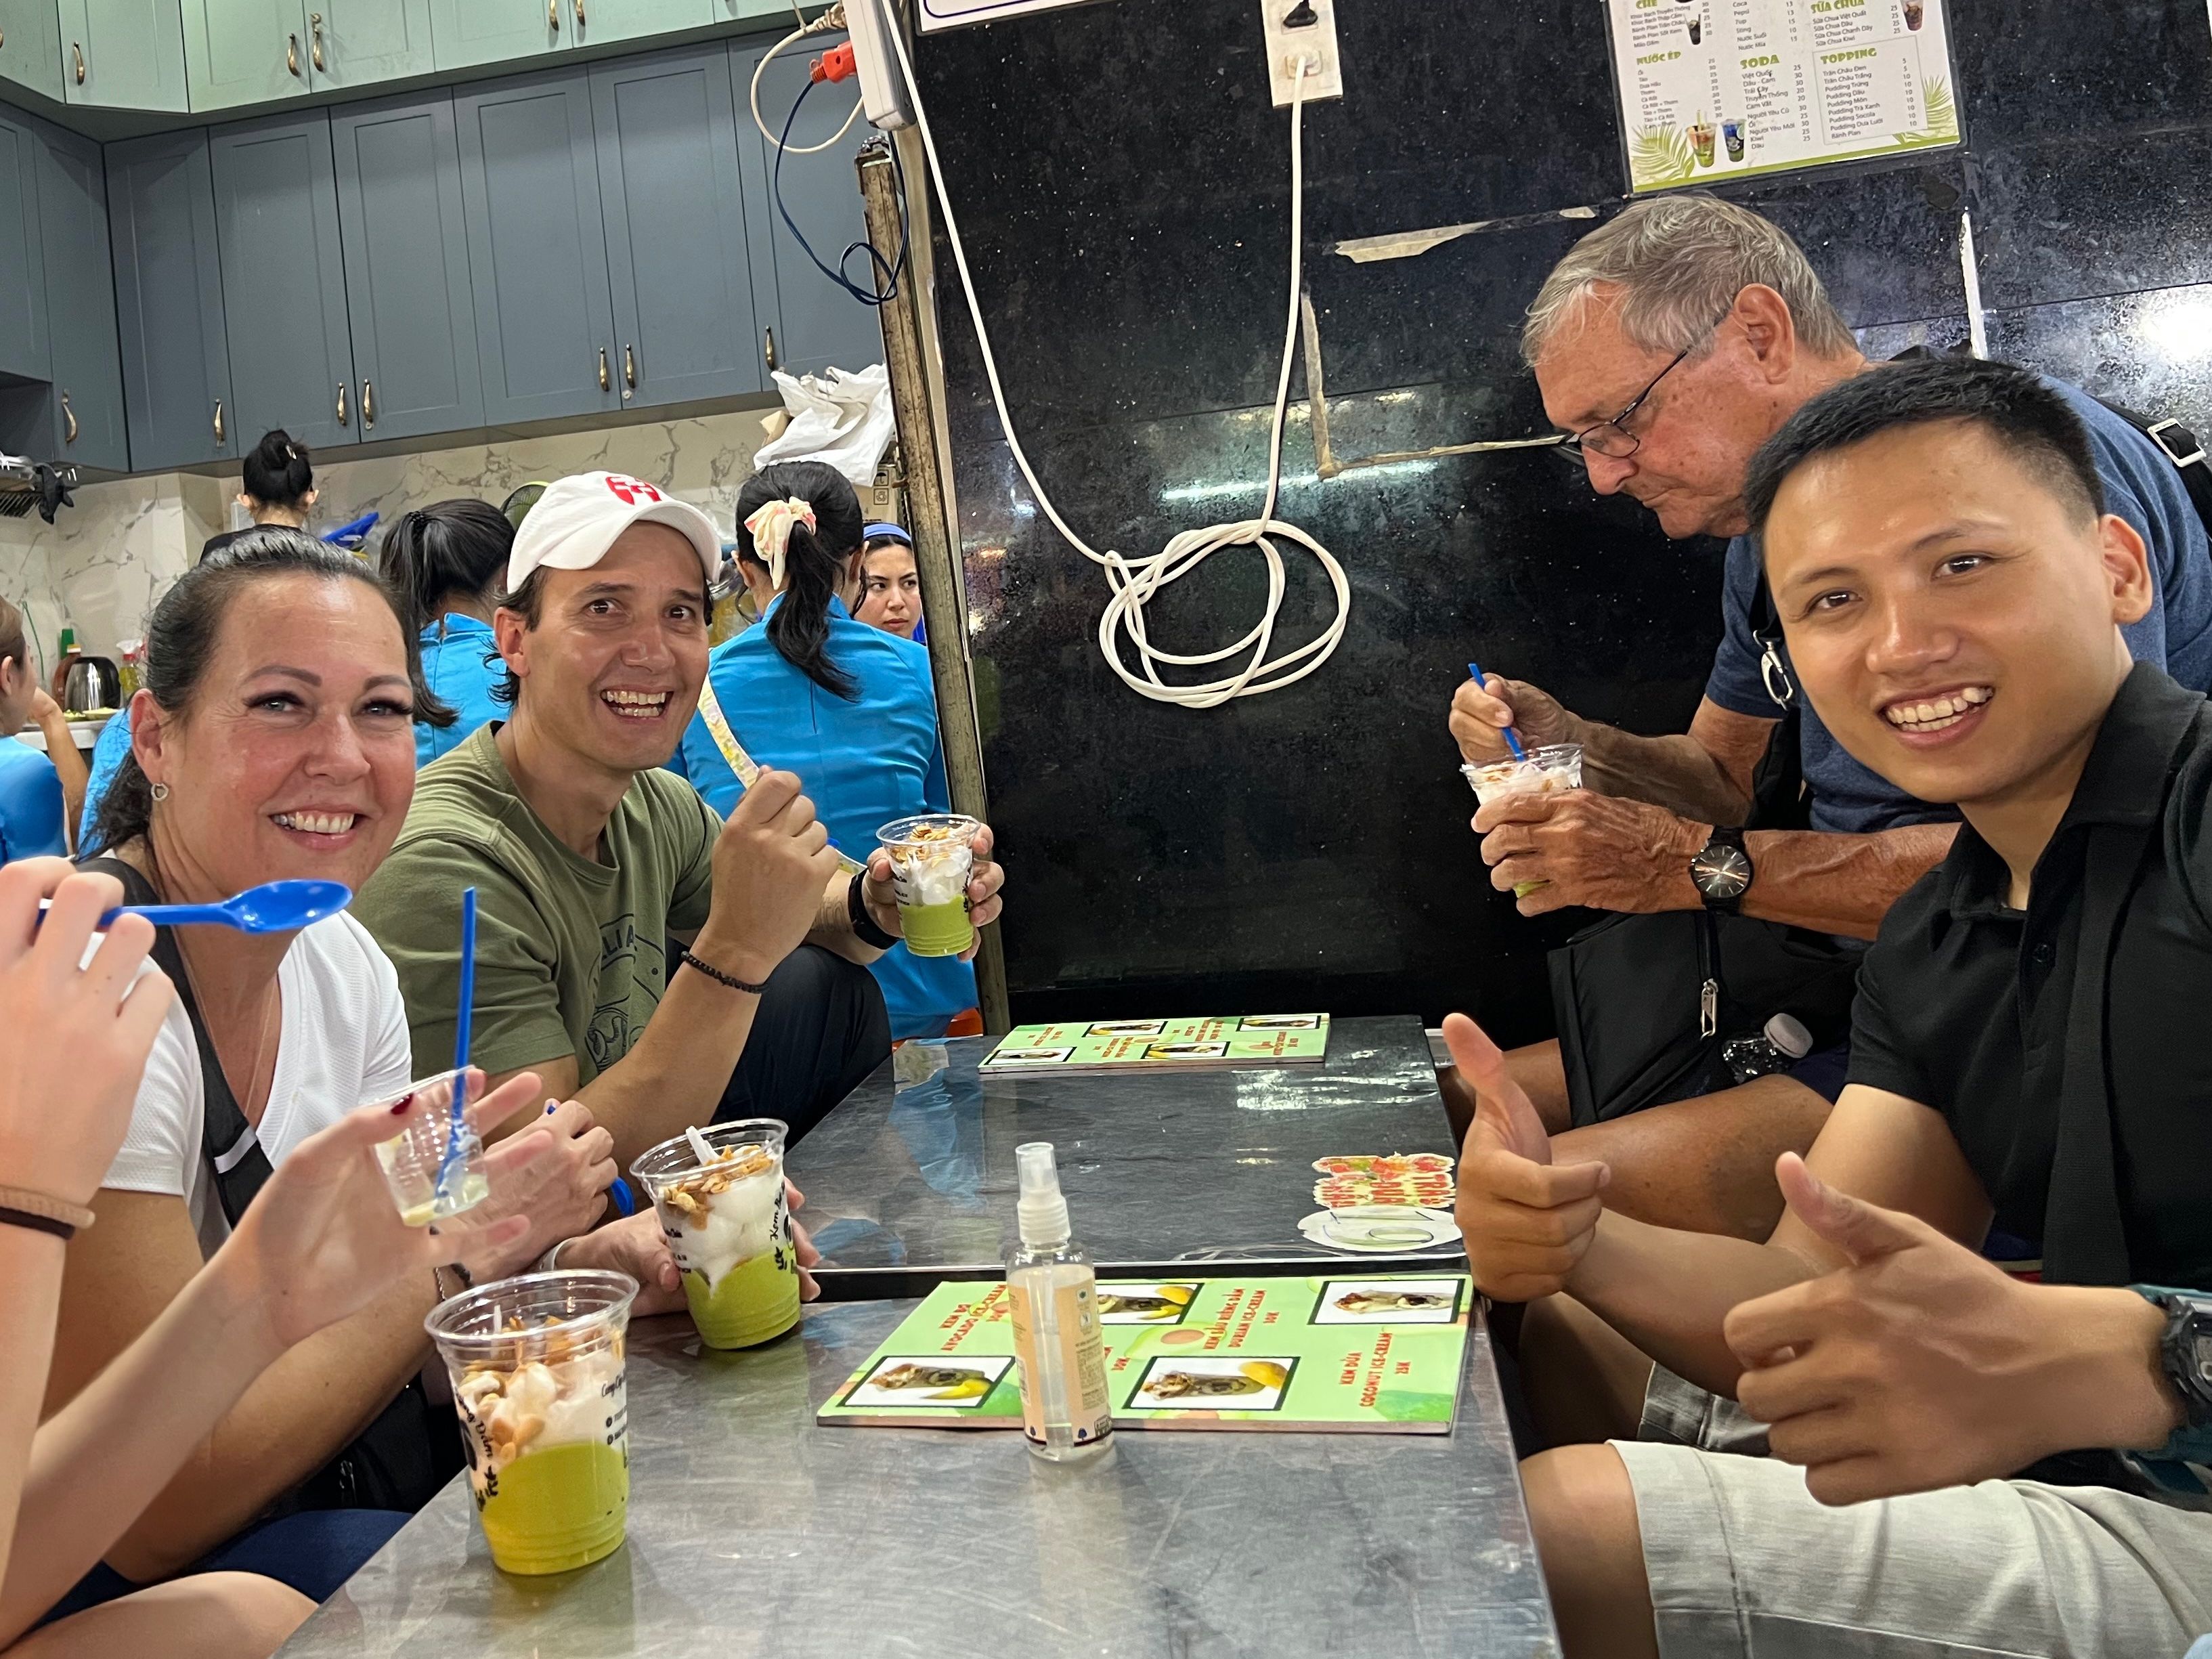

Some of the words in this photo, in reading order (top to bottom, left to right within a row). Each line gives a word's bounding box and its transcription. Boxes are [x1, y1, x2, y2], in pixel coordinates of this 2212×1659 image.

[1740, 54, 1779, 69] SODA
[1820, 48, 1877, 64] TOPPING
[1825, 84, 1850, 92] Pudding
[1827, 100, 1852, 108] Pudding
[1829, 115, 1855, 123] Pudding
[1830, 123, 1856, 131] Pudding
[1228, 1322, 1251, 1348] DURIAN
[1241, 1290, 1267, 1320] ICE-CREAM
[1370, 1333, 1393, 1369] ICE-CREAM
[1339, 1369, 1357, 1385] KEM
[1359, 1371, 1382, 1406] COCONUT
